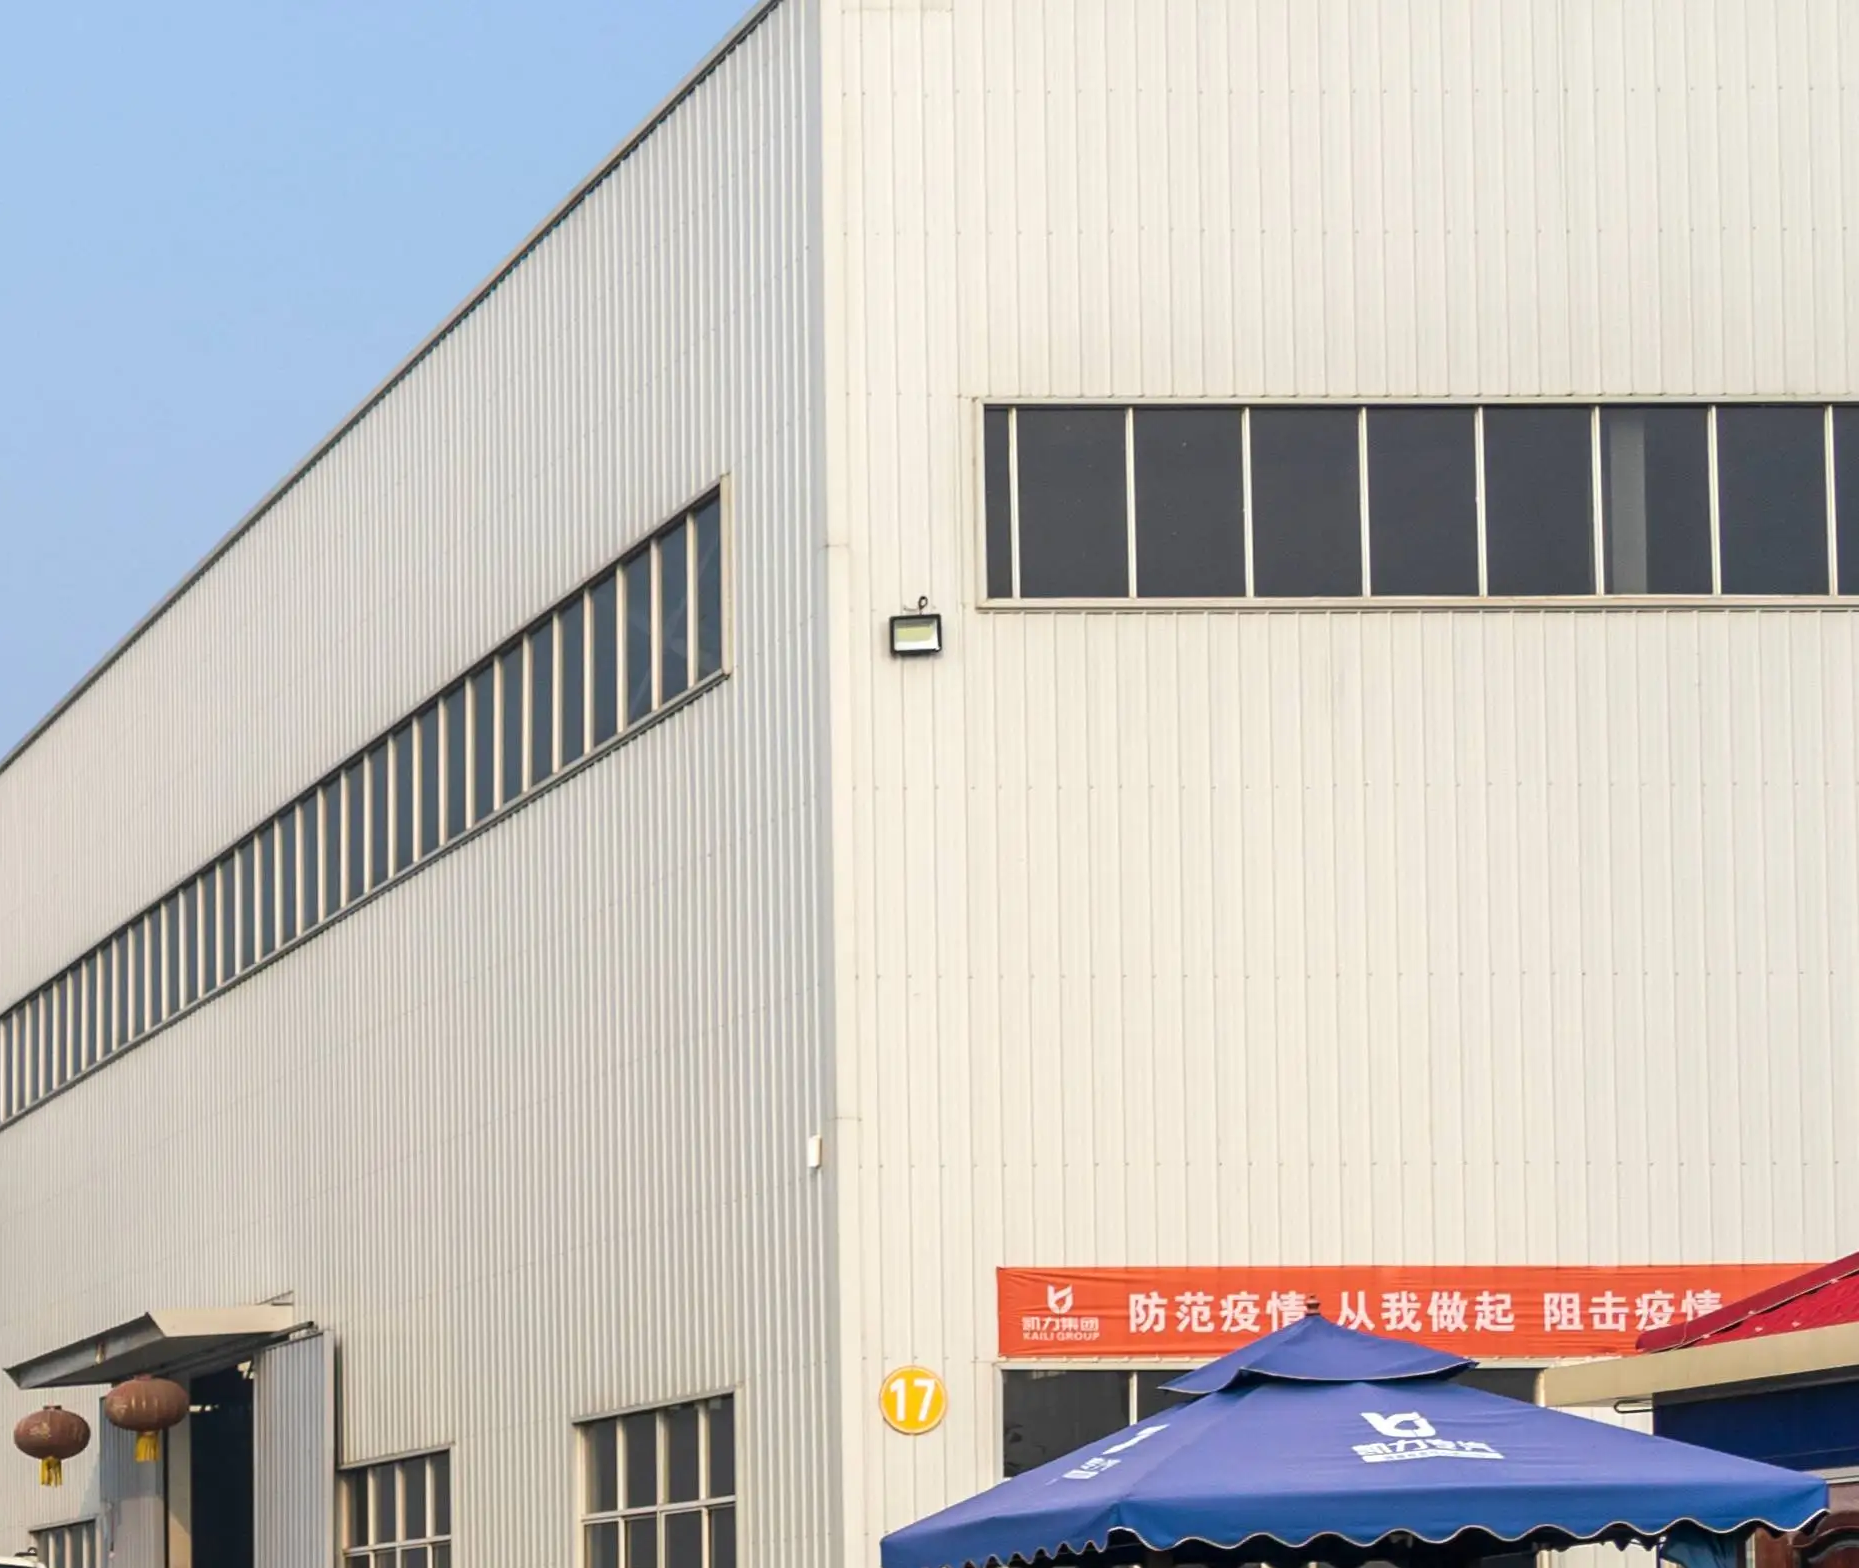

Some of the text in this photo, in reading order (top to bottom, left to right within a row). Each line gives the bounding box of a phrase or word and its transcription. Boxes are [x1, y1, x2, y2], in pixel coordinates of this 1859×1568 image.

[1022, 1316, 1100, 1332] 凯力集团
[1129, 1290, 1723, 1333] 防范疫情 从我做起 阻击疫情
[1023, 1332, 1100, 1341] KAILI GROUP
[890, 1378, 935, 1422] 17
